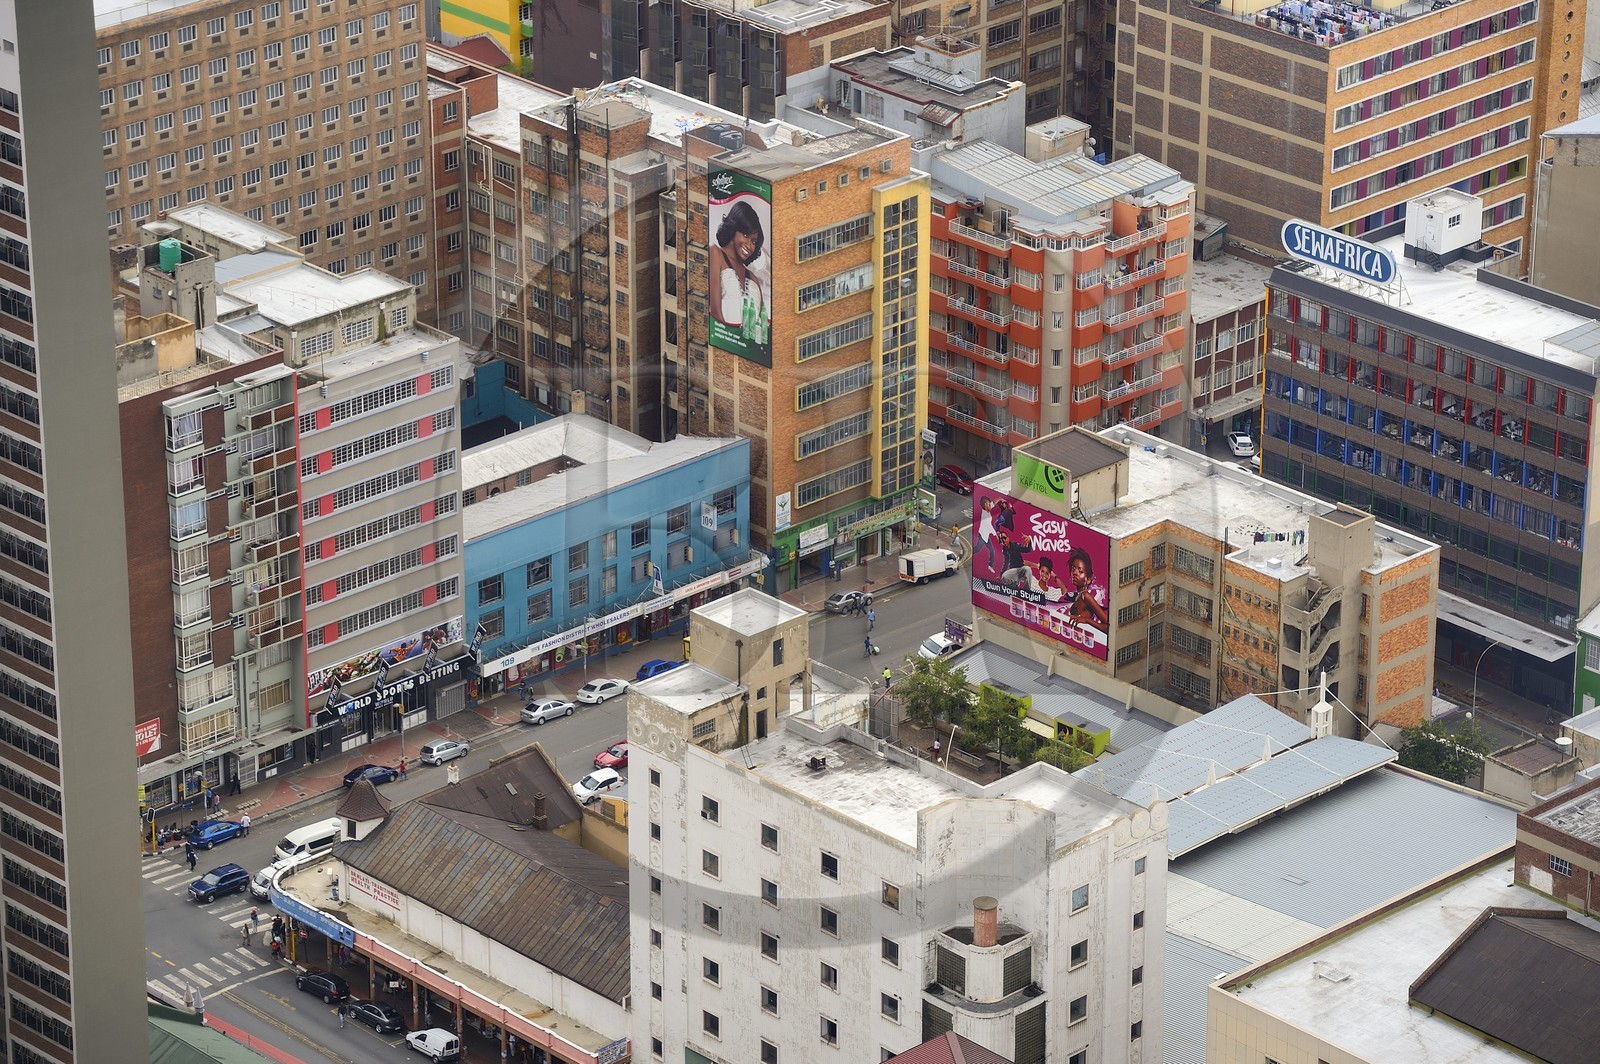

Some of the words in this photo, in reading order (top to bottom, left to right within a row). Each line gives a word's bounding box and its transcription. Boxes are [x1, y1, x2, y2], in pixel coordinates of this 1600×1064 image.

[1293, 226, 1383, 279] SEWAFRICA
[887, 506, 904, 516] HOME
[702, 516, 713, 527] 109
[1029, 535, 1071, 552] Waves
[986, 581, 1001, 592] Own
[1002, 584, 1018, 596] Your
[1020, 589, 1041, 602] Style!
[541, 635, 566, 650] FASHION
[565, 627, 590, 640] DISTRICT
[590, 610, 630, 632] WHOLESALERS
[501, 656, 515, 668] 109
[337, 696, 371, 716] WORLD
[419, 662, 460, 685] BETTING
[135, 733, 144, 742] TO
[145, 728, 157, 739] LET
[351, 877, 370, 890] HEALTH
[373, 888, 399, 906] PRACTICE
